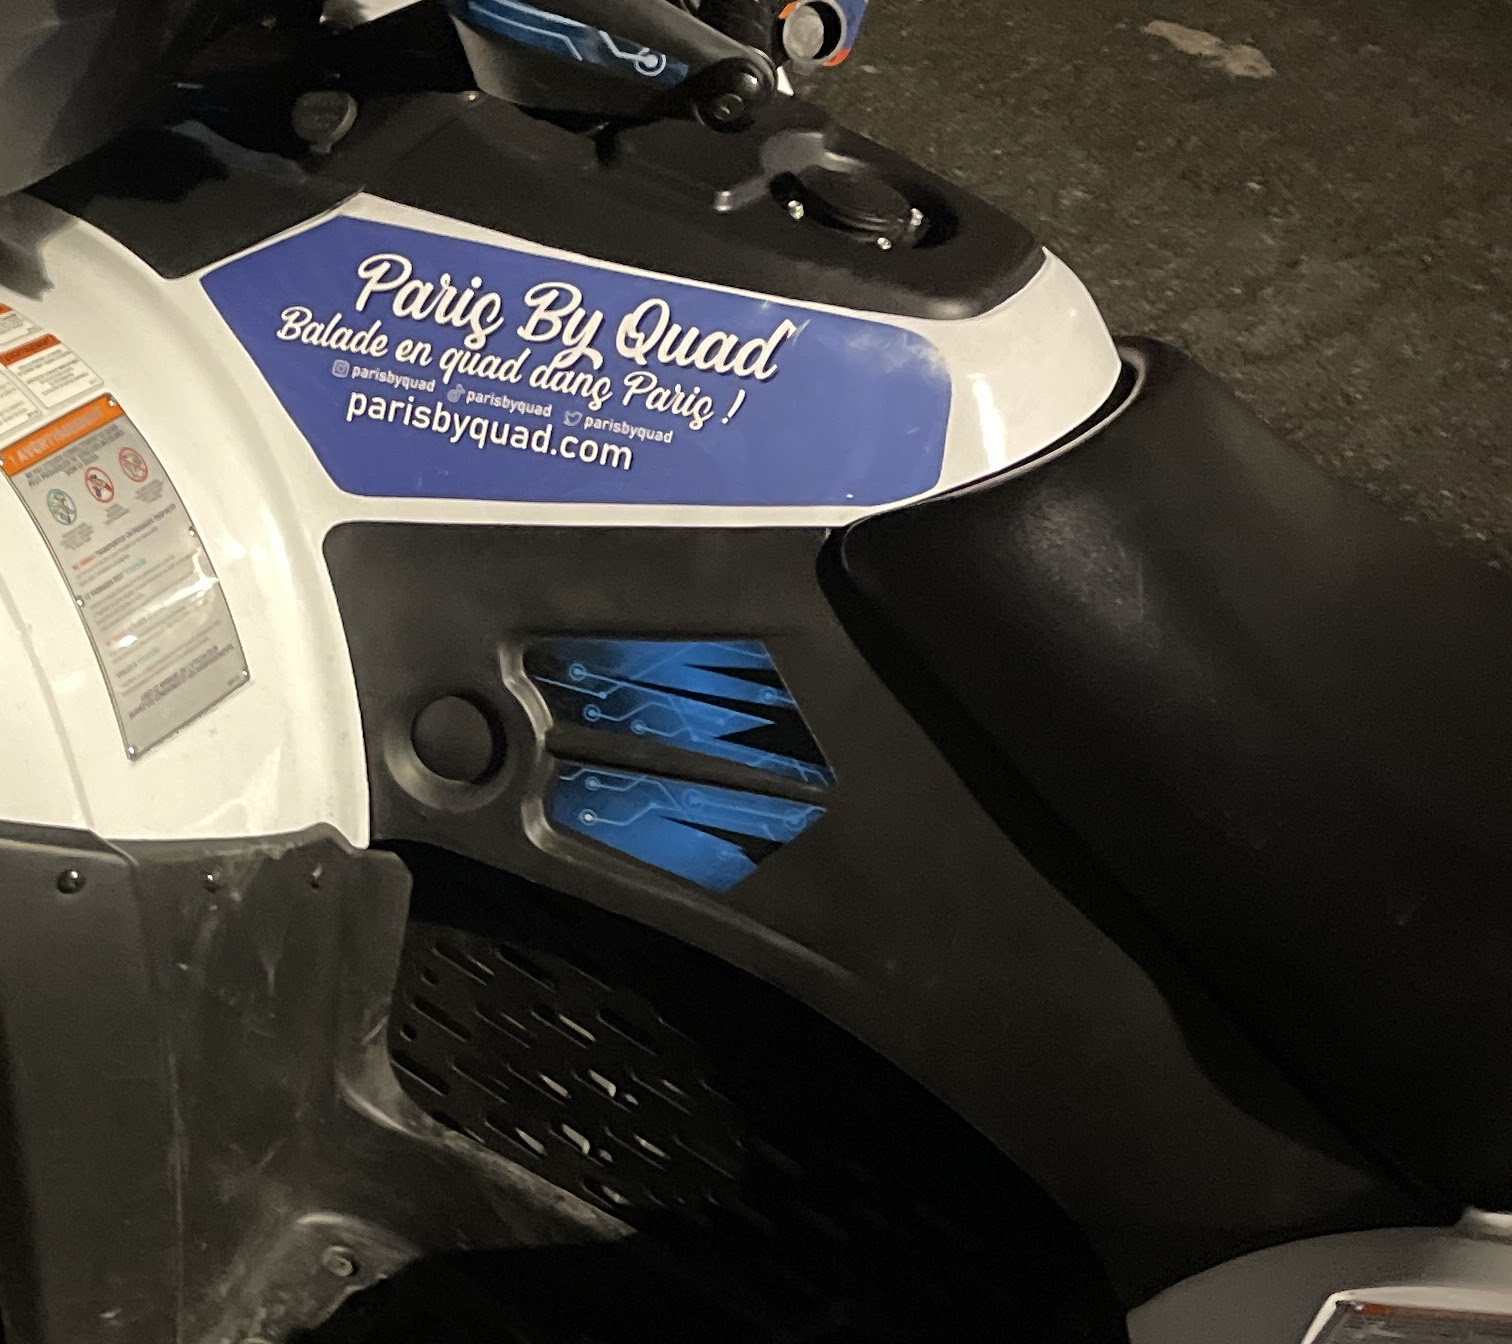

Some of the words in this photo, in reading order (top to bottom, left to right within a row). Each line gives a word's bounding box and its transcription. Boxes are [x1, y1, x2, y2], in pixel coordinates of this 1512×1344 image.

[276, 305, 389, 358] Balade
[394, 338, 434, 368] en
[438, 347, 532, 386] quad
[528, 349, 614, 412] dans
[621, 370, 715, 432] Paris
[720, 388, 747, 426] !
[355, 252, 505, 350] Paris
[516, 281, 605, 371] By
[615, 297, 798, 381] Quad
[345, 390, 635, 472] parisbyquad.com
[351, 364, 437, 393] parisbyquad
[465, 388, 554, 419] parisbyquad
[583, 414, 675, 445] parisbyquad
